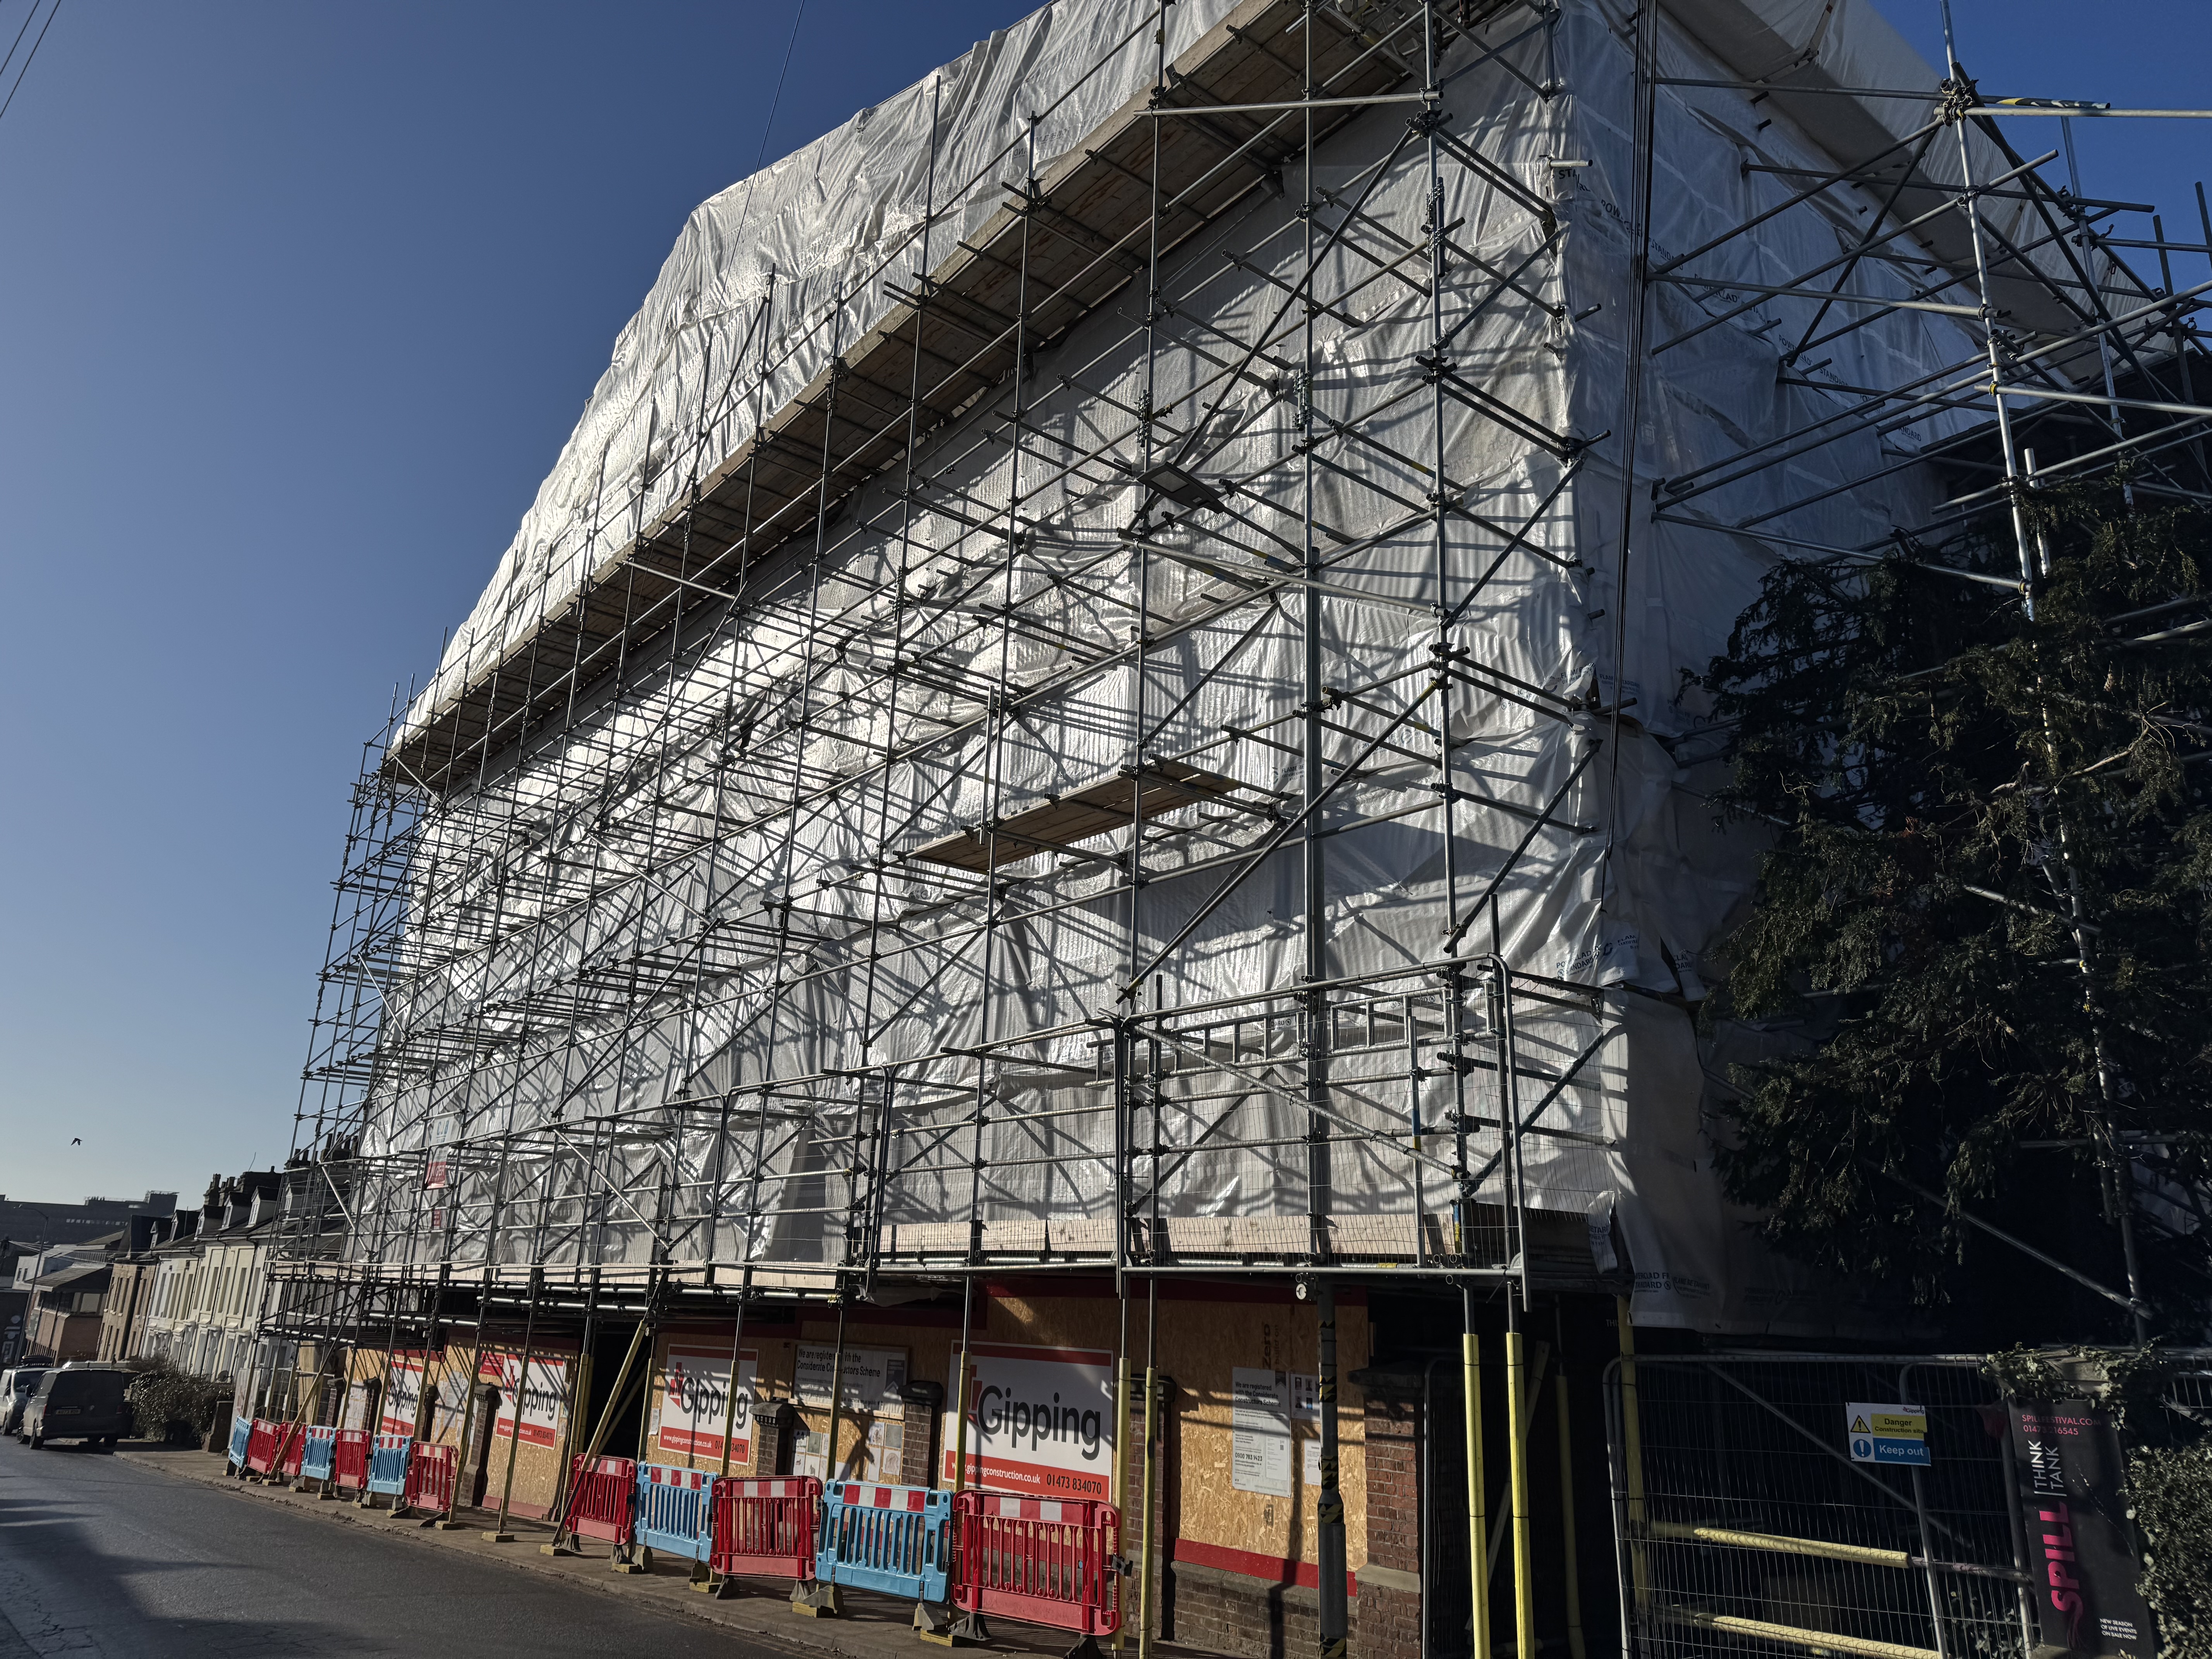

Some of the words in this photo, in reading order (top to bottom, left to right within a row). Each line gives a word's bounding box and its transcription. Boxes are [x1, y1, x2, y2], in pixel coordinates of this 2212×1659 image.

[797, 1360, 826, 1371] Considerate
[860, 1366, 880, 1377] Scheme
[799, 1348, 805, 1358] We
[852, 1353, 861, 1363] the
[388, 1381, 419, 1418] Gipping
[512, 1378, 556, 1421] Gpping
[680, 1377, 748, 1430] Gippig
[1235, 1396, 1263, 1405] Constructors
[1252, 1391, 1279, 1399] Considerate
[978, 1385, 1101, 1461] Gipping
[1884, 1418, 1912, 1427] Danger
[2022, 1414, 2101, 1425] SPILLFESTIVAL.COM
[1879, 1445, 1905, 1456] Keep
[1907, 1448, 1924, 1456] out
[2028, 1440, 2047, 1488] THINK
[951, 1462, 1040, 1485] w.gippingconstruction.co.uk
[1047, 1473, 1070, 1489] 01473
[1072, 1476, 1102, 1495] 834070
[2045, 1446, 2064, 1489] TANK
[2039, 1501, 2084, 1626] SPILL
